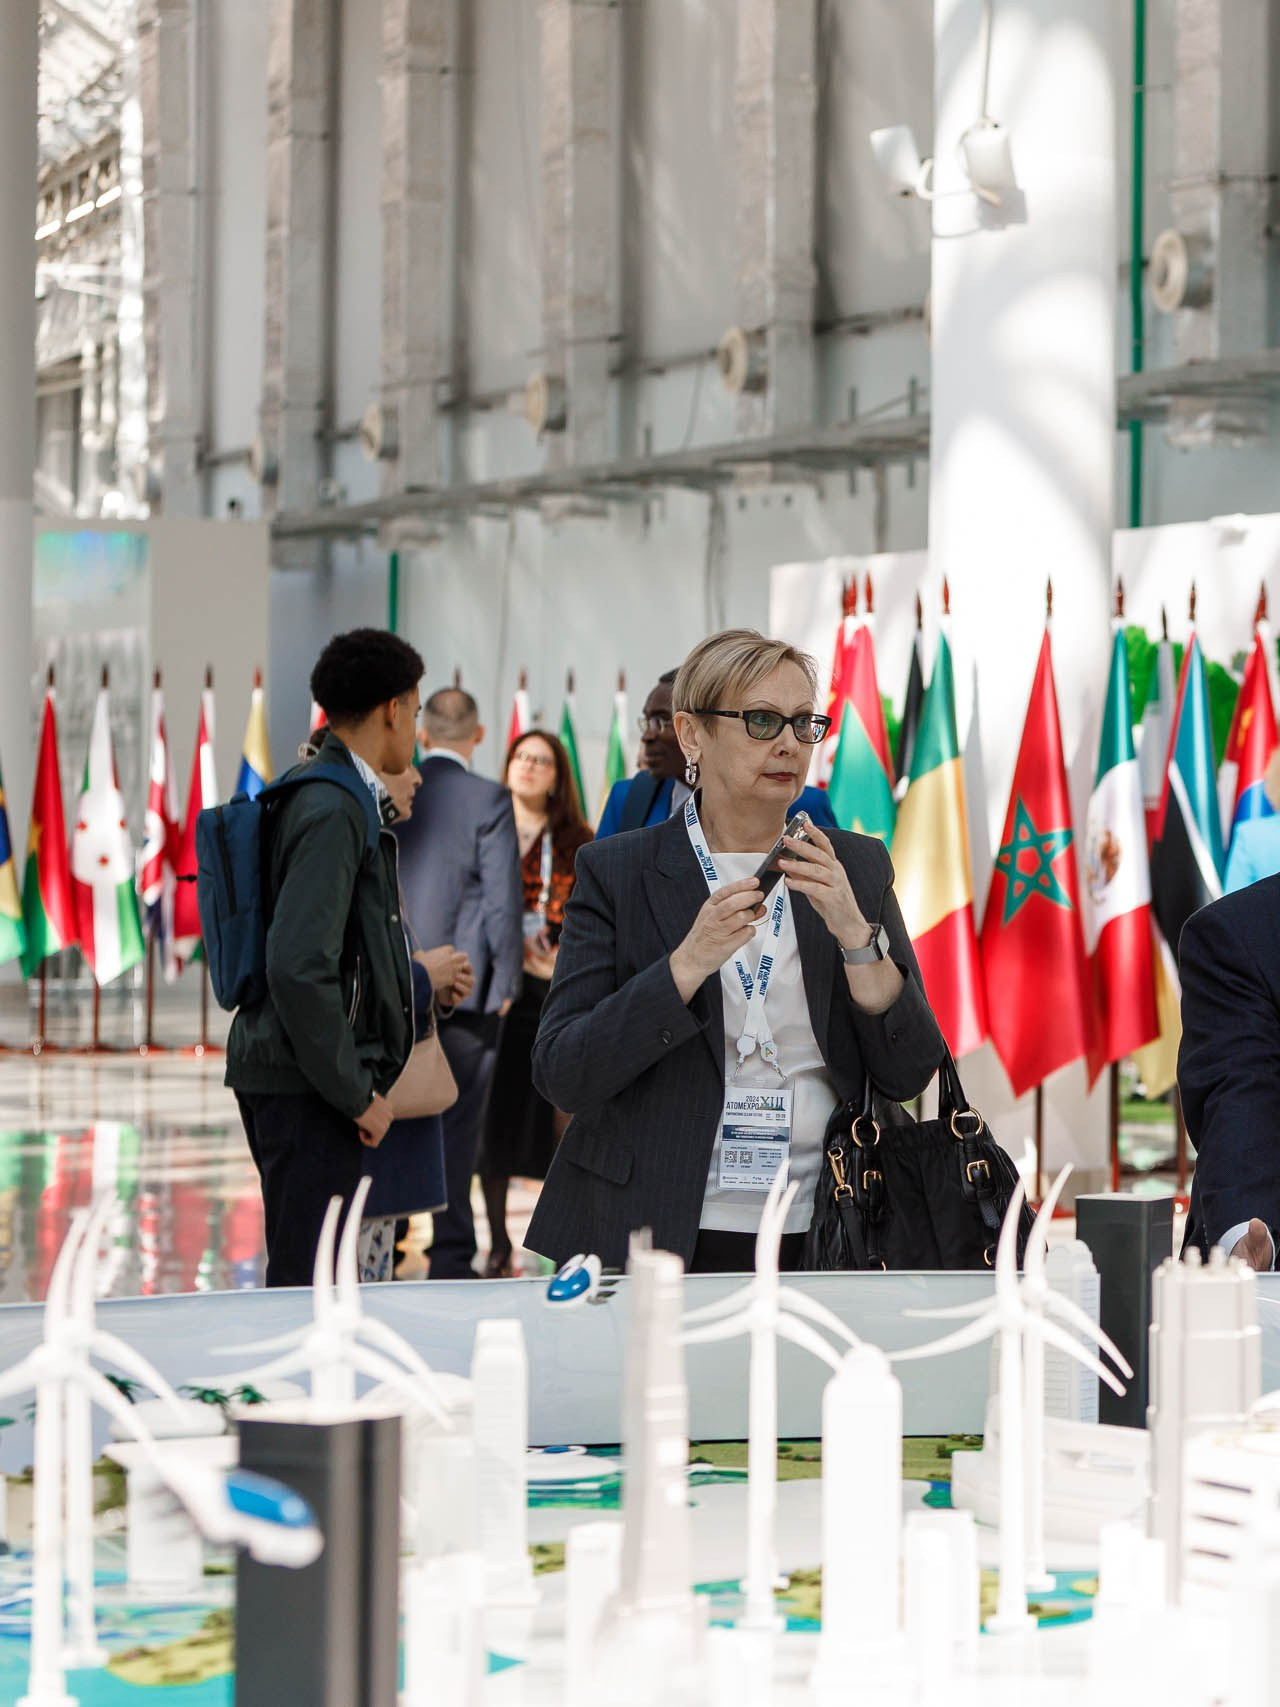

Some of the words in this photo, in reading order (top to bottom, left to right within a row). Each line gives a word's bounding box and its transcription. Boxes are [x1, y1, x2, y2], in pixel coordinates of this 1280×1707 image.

[759, 954, 774, 975] XIII
[745, 1095, 760, 1103] 2024
[726, 1101, 760, 1111] ATOMEXPO
